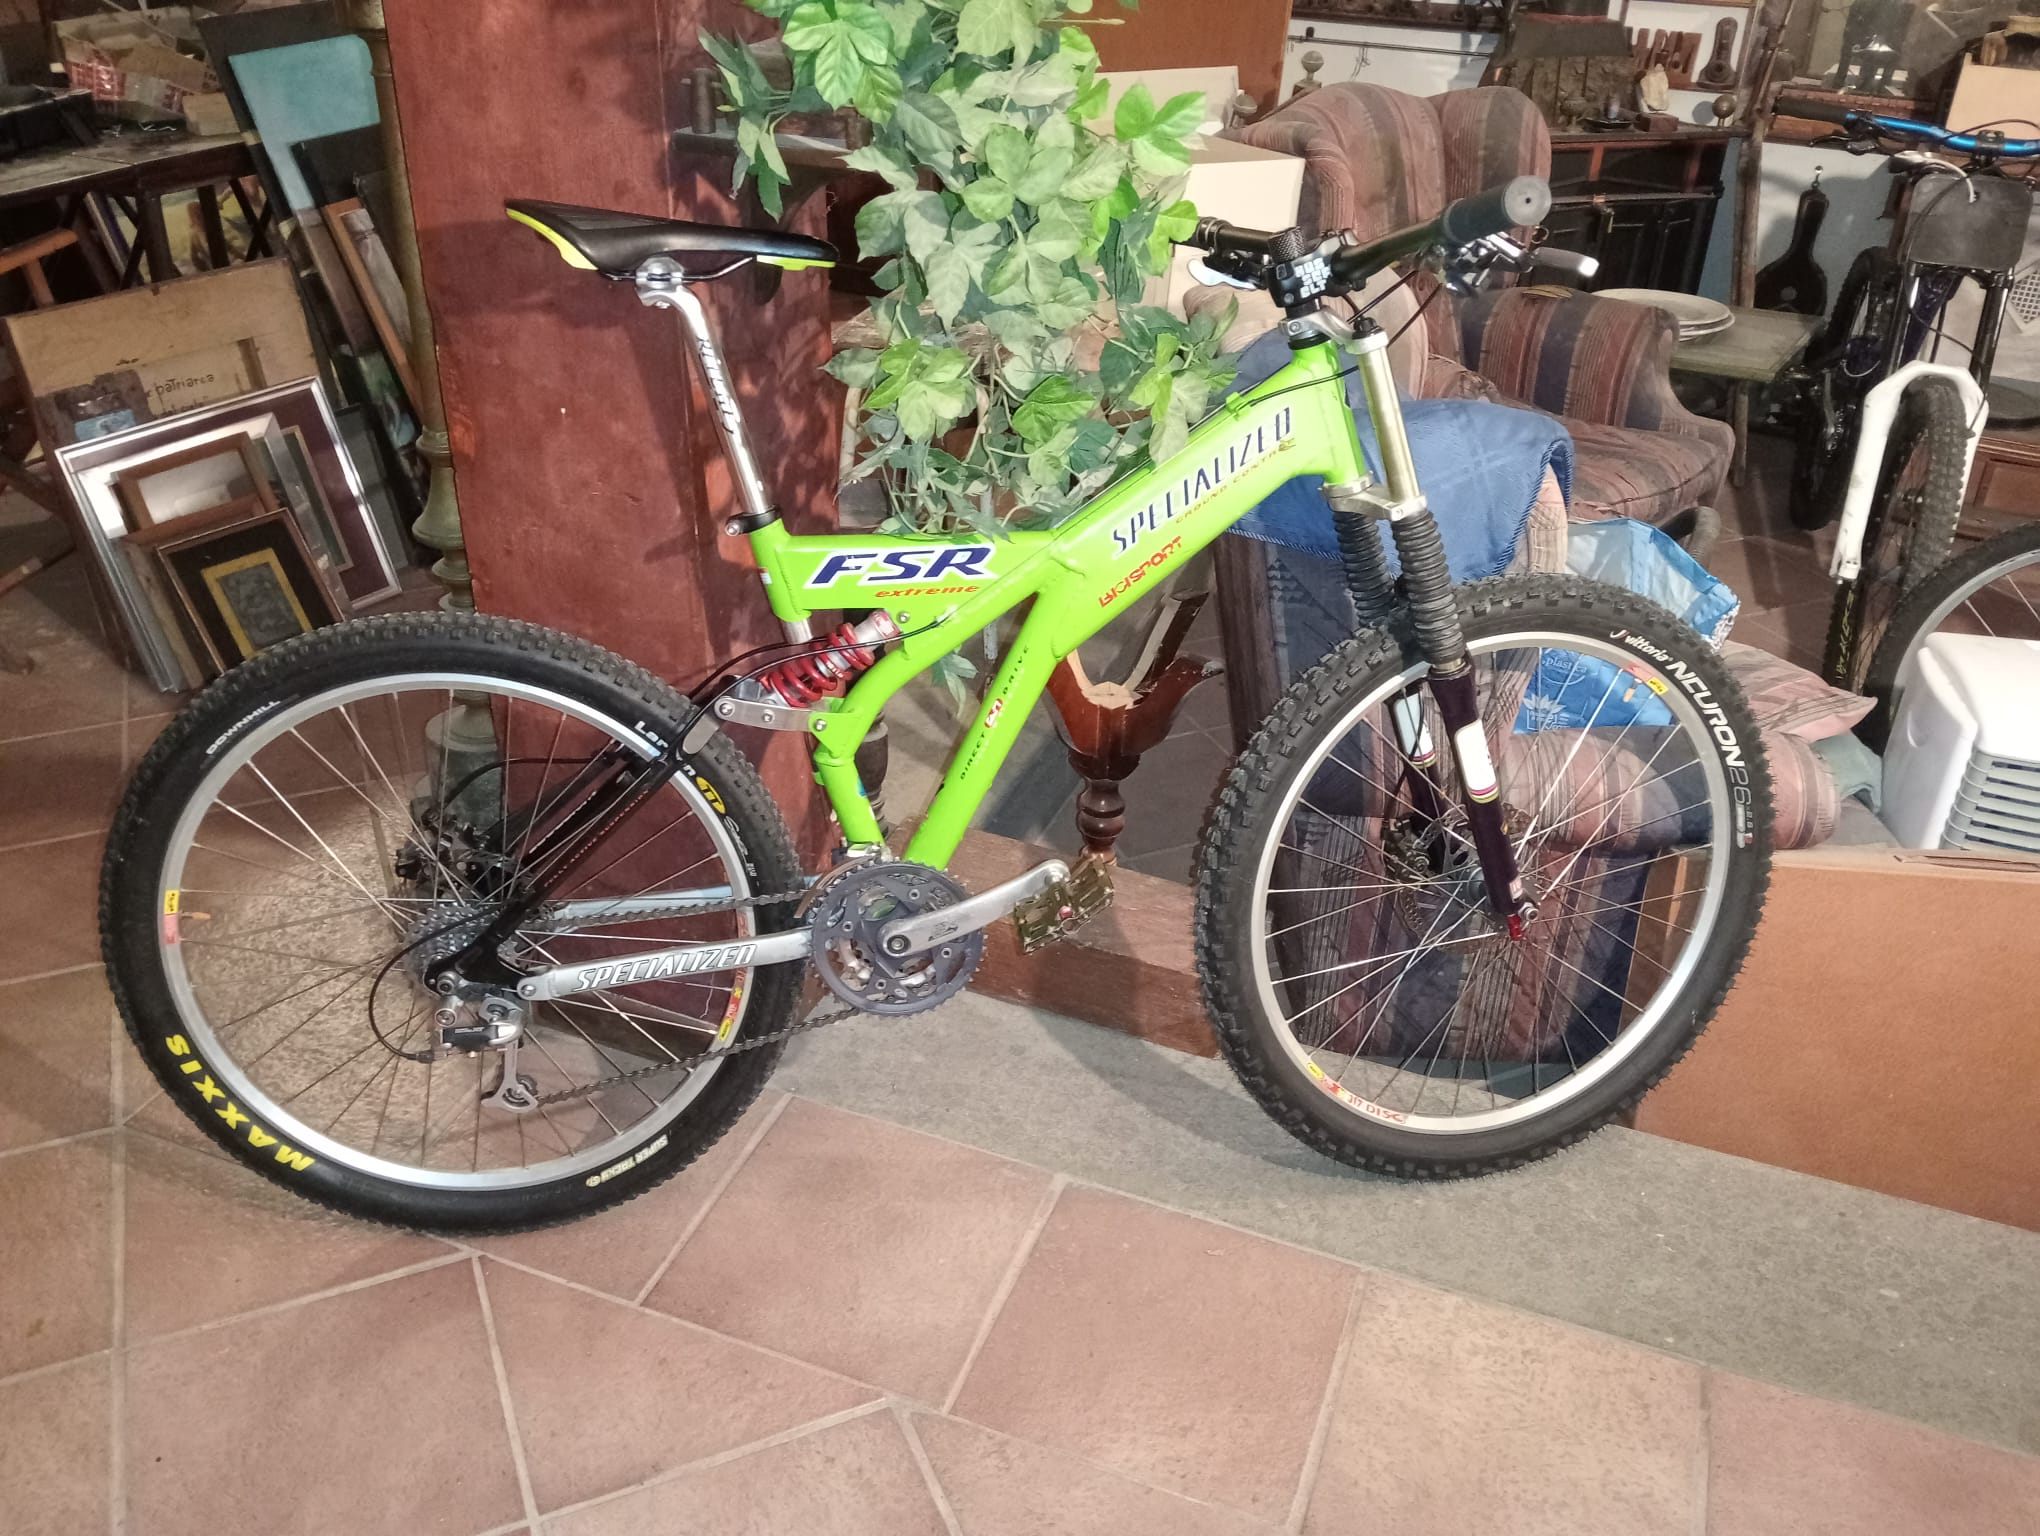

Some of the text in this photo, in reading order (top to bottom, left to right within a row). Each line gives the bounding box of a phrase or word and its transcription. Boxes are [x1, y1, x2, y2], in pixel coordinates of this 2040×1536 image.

[1112, 405, 1292, 553] SPECIALIZED
[811, 547, 992, 585] FSR
[875, 584, 980, 599] extreme
[1624, 635, 1671, 663] vittoria
[206, 700, 281, 755] DOWNHILL
[960, 731, 985, 780] DIRECT
[571, 943, 758, 993] SPECIALIZED
[165, 1034, 316, 1172] MAXXIS
[634, 1134, 669, 1164] SUPER
